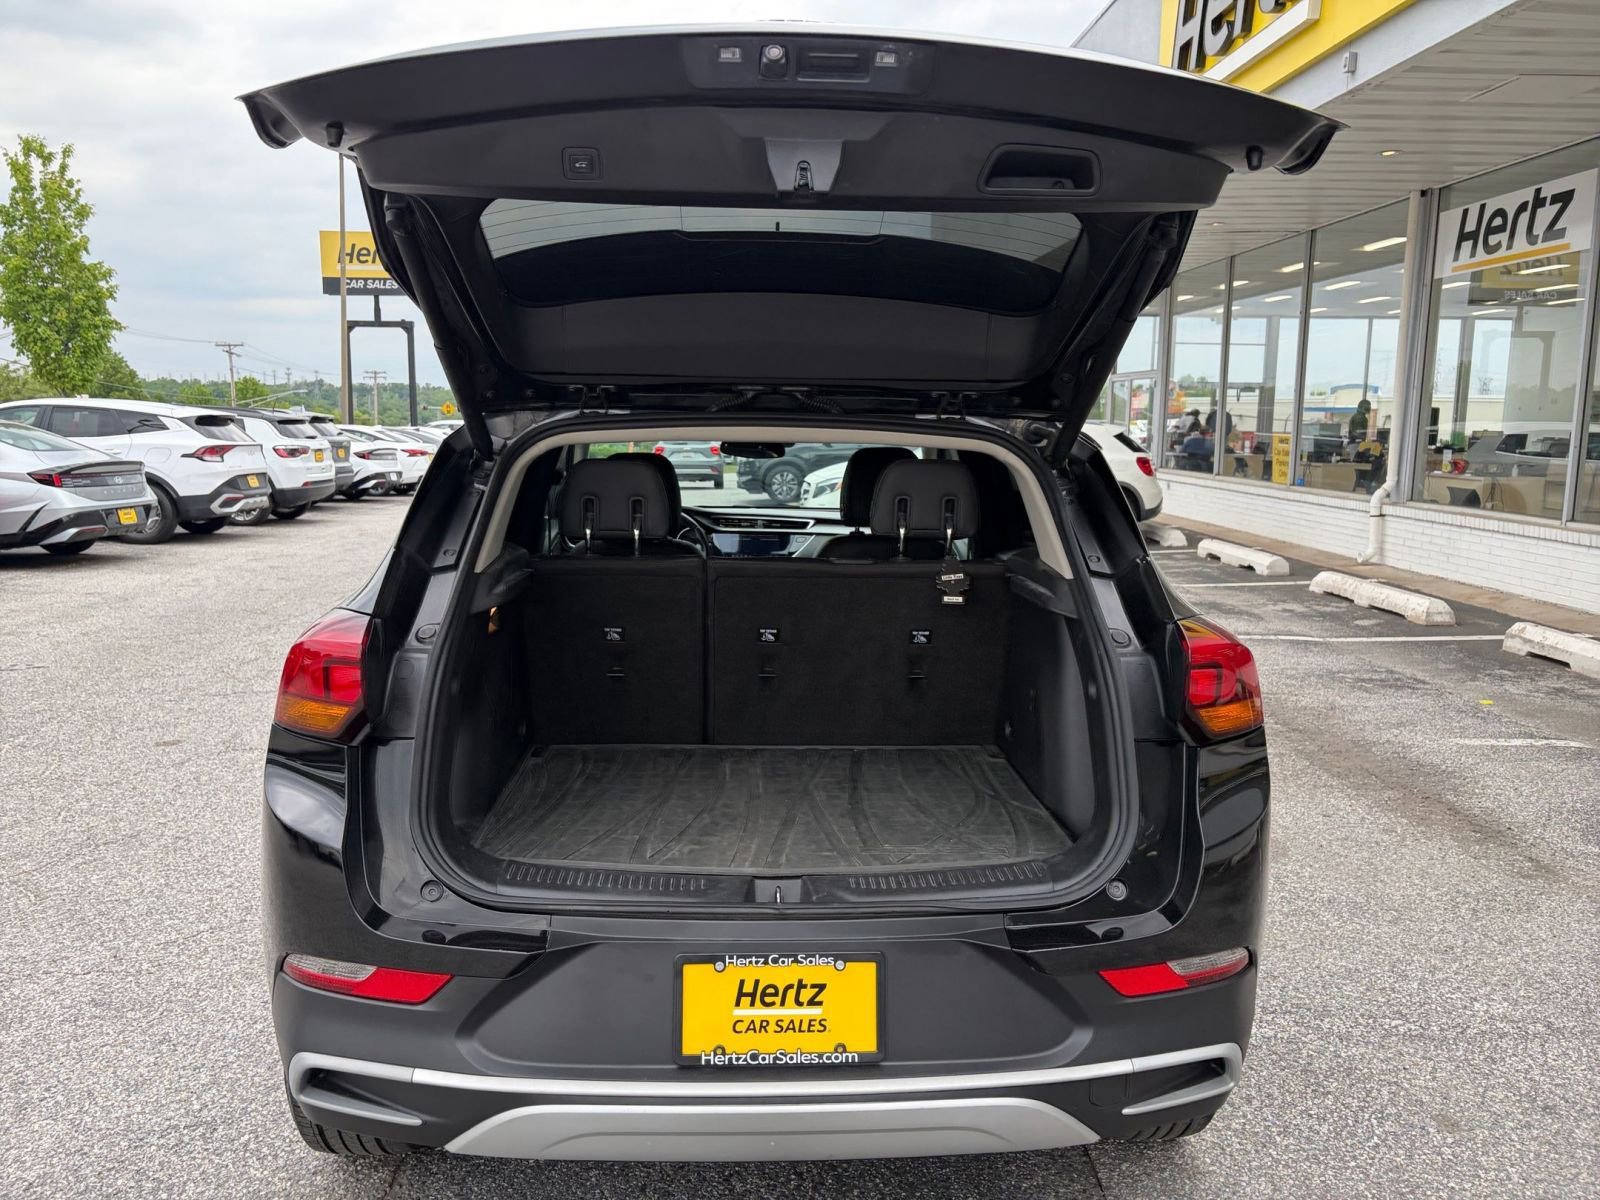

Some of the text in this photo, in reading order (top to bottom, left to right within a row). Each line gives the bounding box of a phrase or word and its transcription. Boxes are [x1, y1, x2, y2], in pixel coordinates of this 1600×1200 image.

[1452, 186, 1576, 262] Hertz
[337, 243, 378, 264] Her
[366, 279, 399, 289] SALES
[725, 954, 835, 967] Hertz Car Sales
[734, 978, 827, 1007] Hertz
[732, 1018, 828, 1034] CAR SALES
[701, 1049, 859, 1065] HertzCarSales.com
